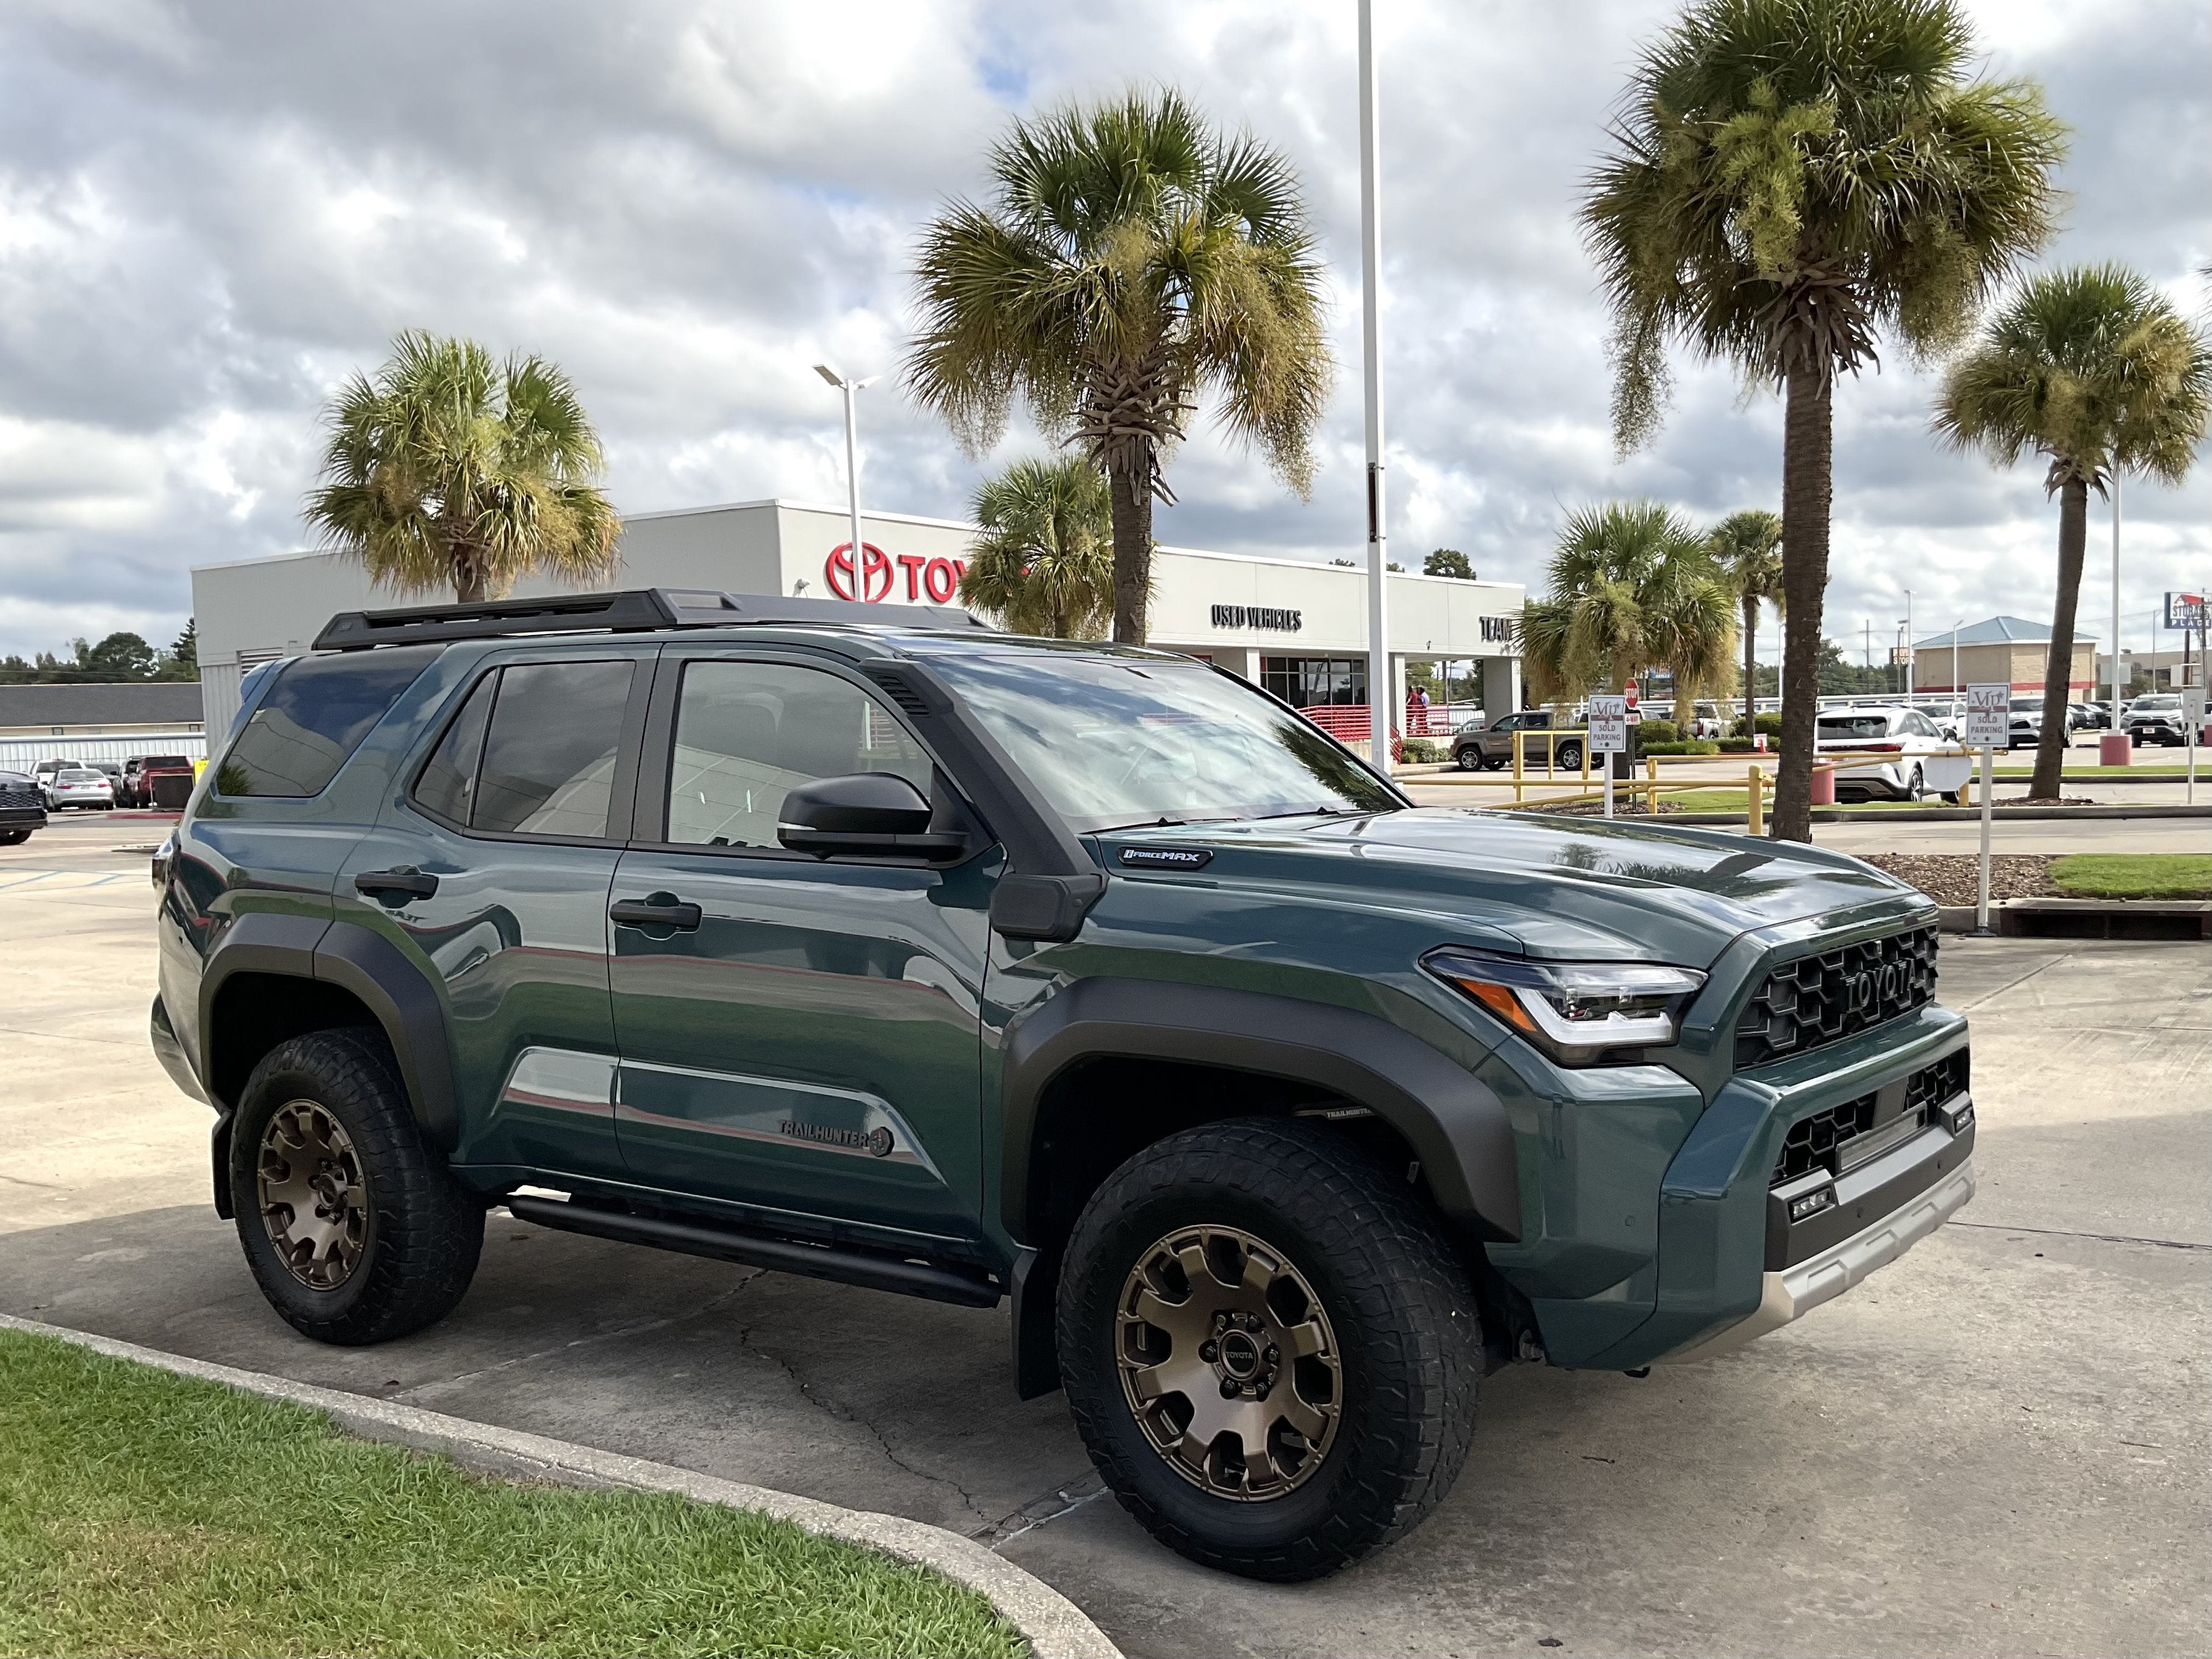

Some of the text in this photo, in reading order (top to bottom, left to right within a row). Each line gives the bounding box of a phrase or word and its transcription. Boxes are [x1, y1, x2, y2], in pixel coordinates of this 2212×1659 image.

[1211, 604, 1302, 630] USED VEHICLES
[1479, 616, 1513, 642] TEAM
[1625, 688, 1638, 699] STOP
[1840, 957, 1915, 1010] TOYOTA
[777, 1119, 870, 1148] TRAILHUNTER
[1225, 1351, 1253, 1359] TOYOTA
